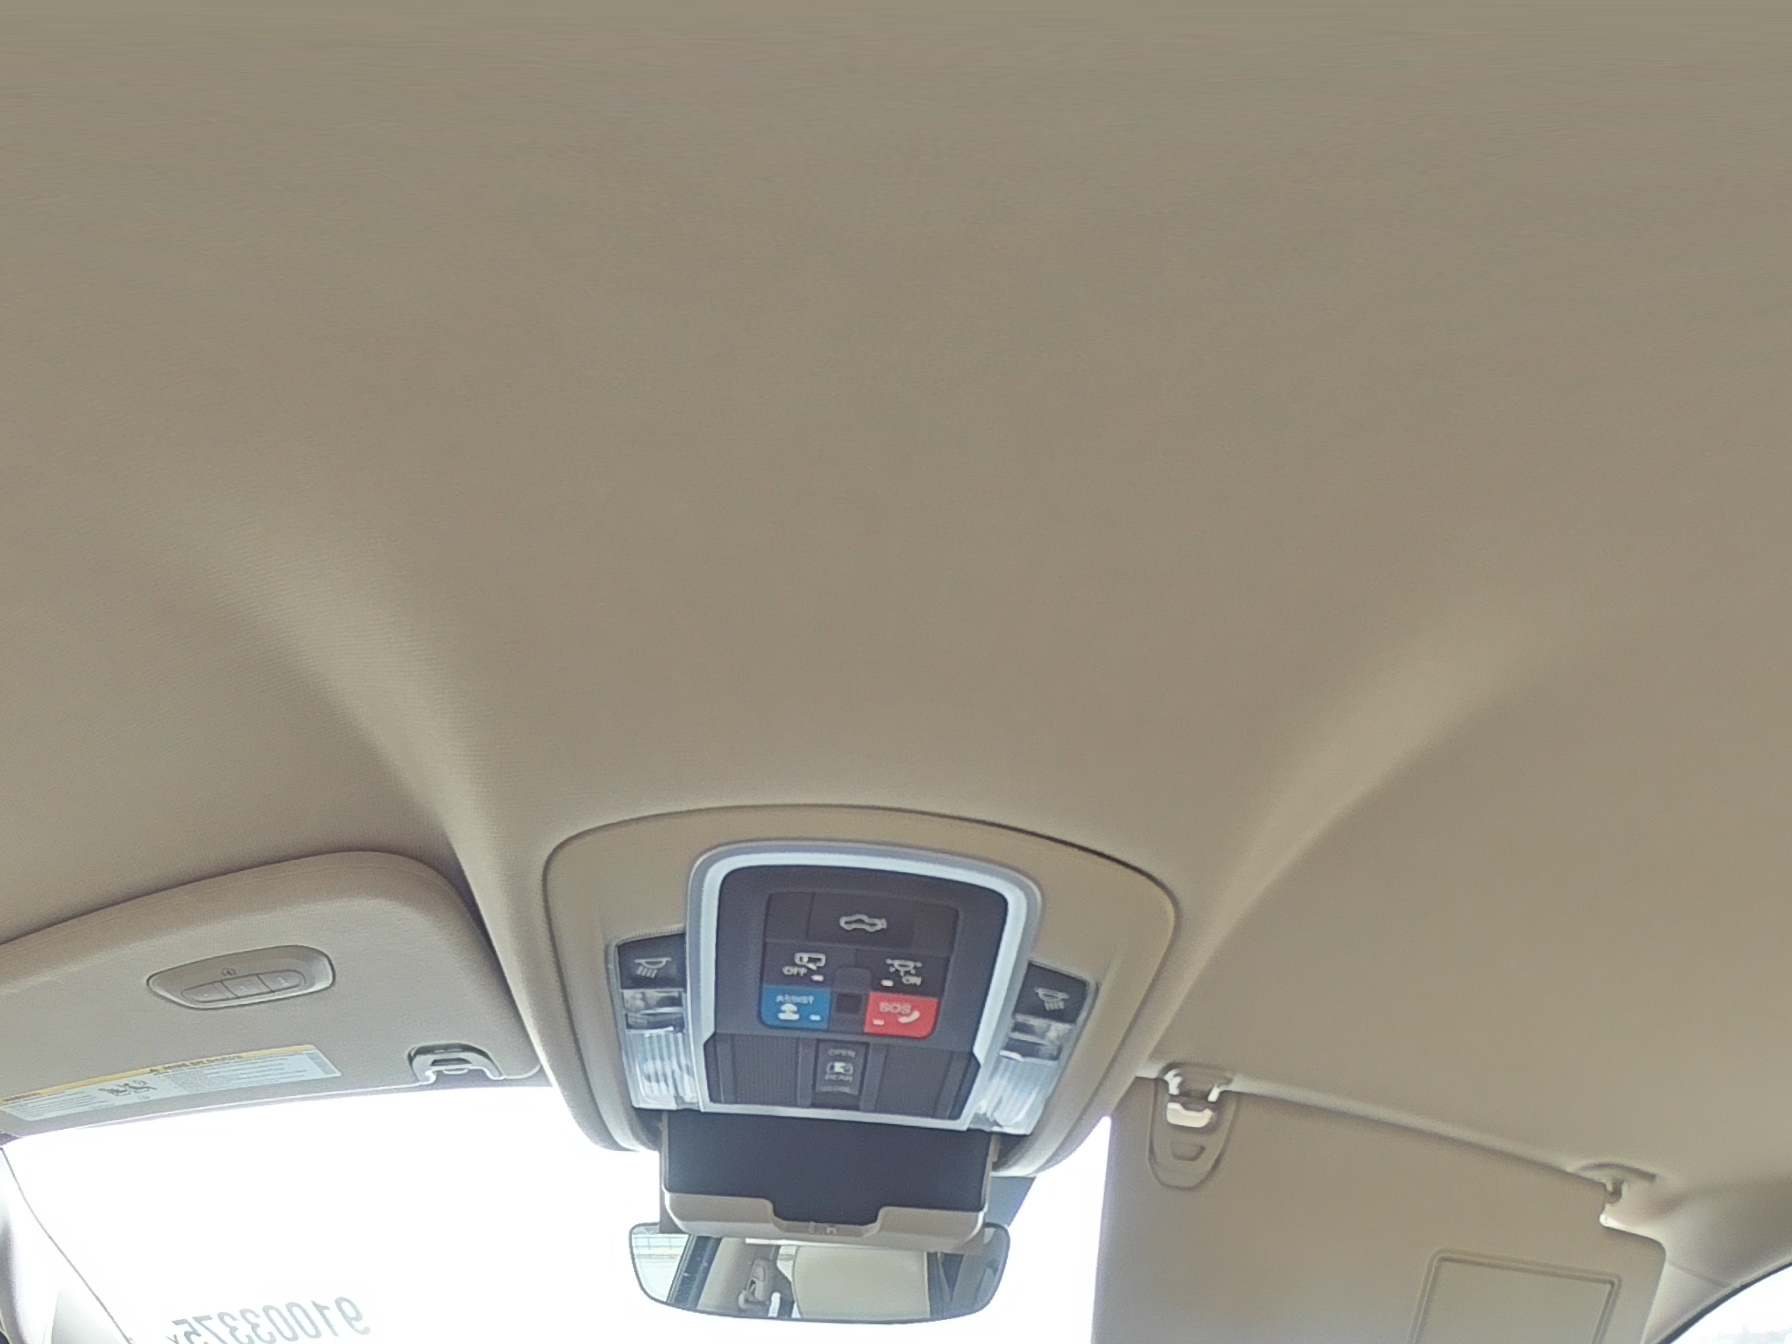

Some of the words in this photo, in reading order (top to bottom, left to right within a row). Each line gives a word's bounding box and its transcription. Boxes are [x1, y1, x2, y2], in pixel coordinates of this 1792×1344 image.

[782, 966, 808, 977] OFF
[901, 976, 922, 986] ON
[879, 1001, 912, 1014] SOS
